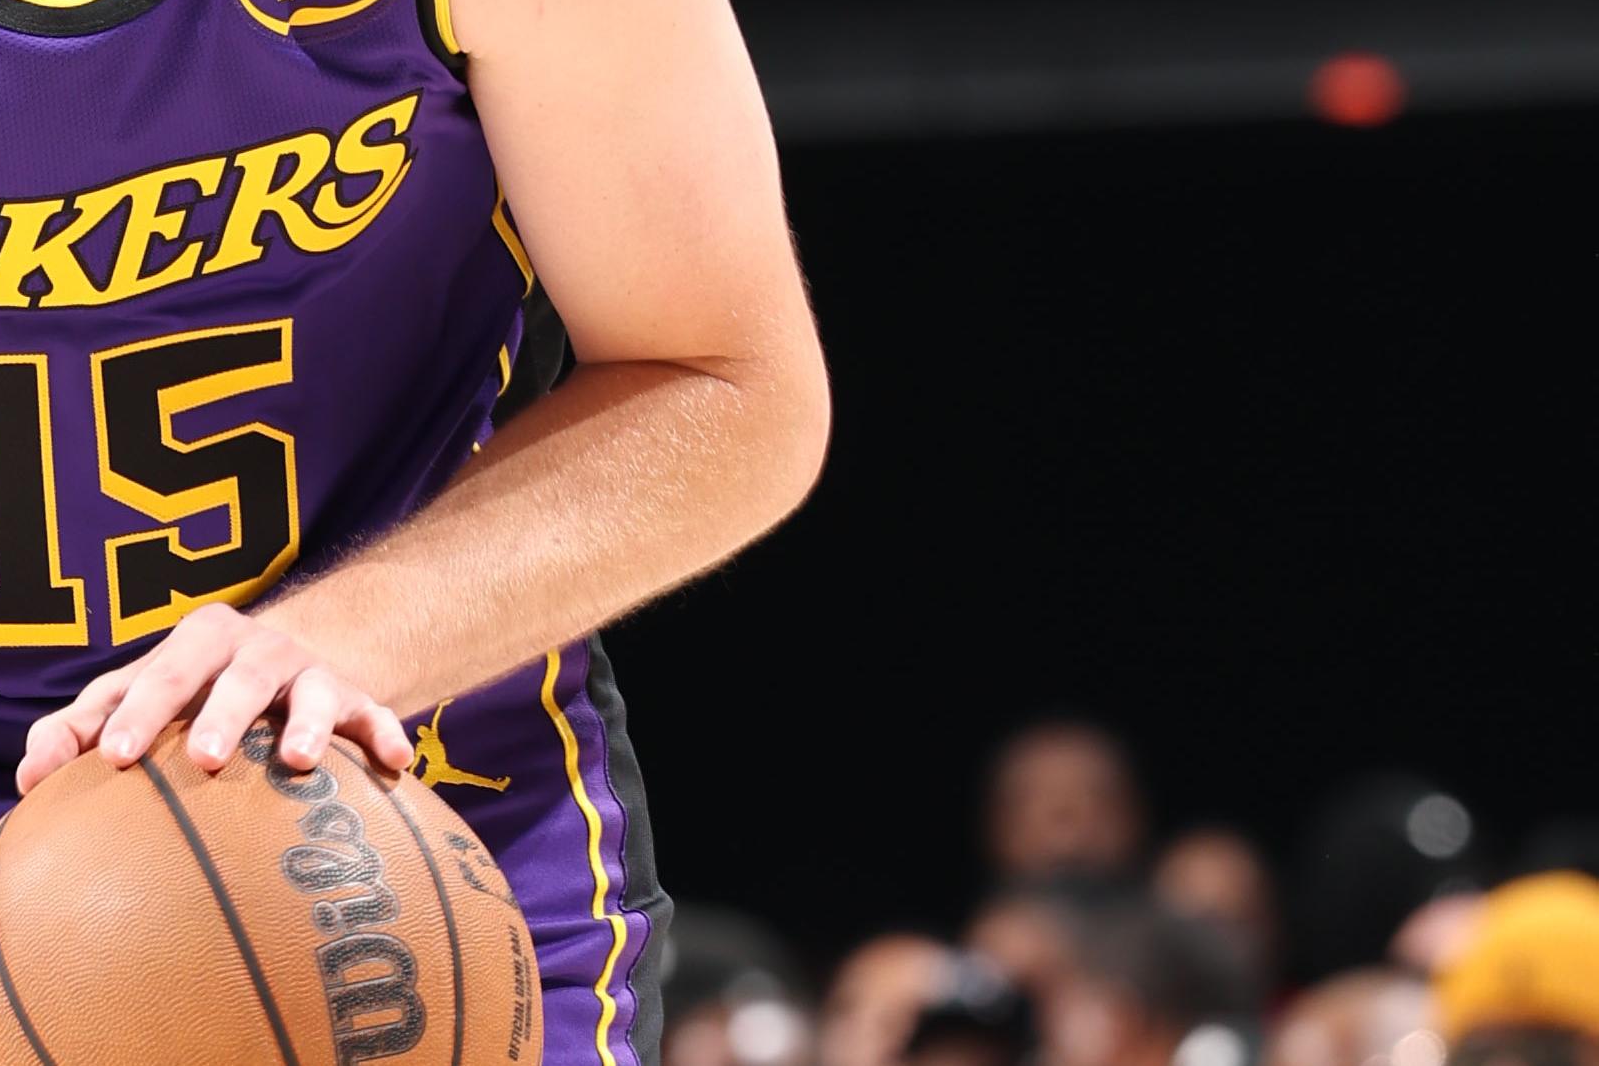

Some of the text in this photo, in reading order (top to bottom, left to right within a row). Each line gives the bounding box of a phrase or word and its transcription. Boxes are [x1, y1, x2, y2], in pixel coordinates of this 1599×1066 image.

[507, 925, 525, 1062] OFFICIAL GAME BALL
